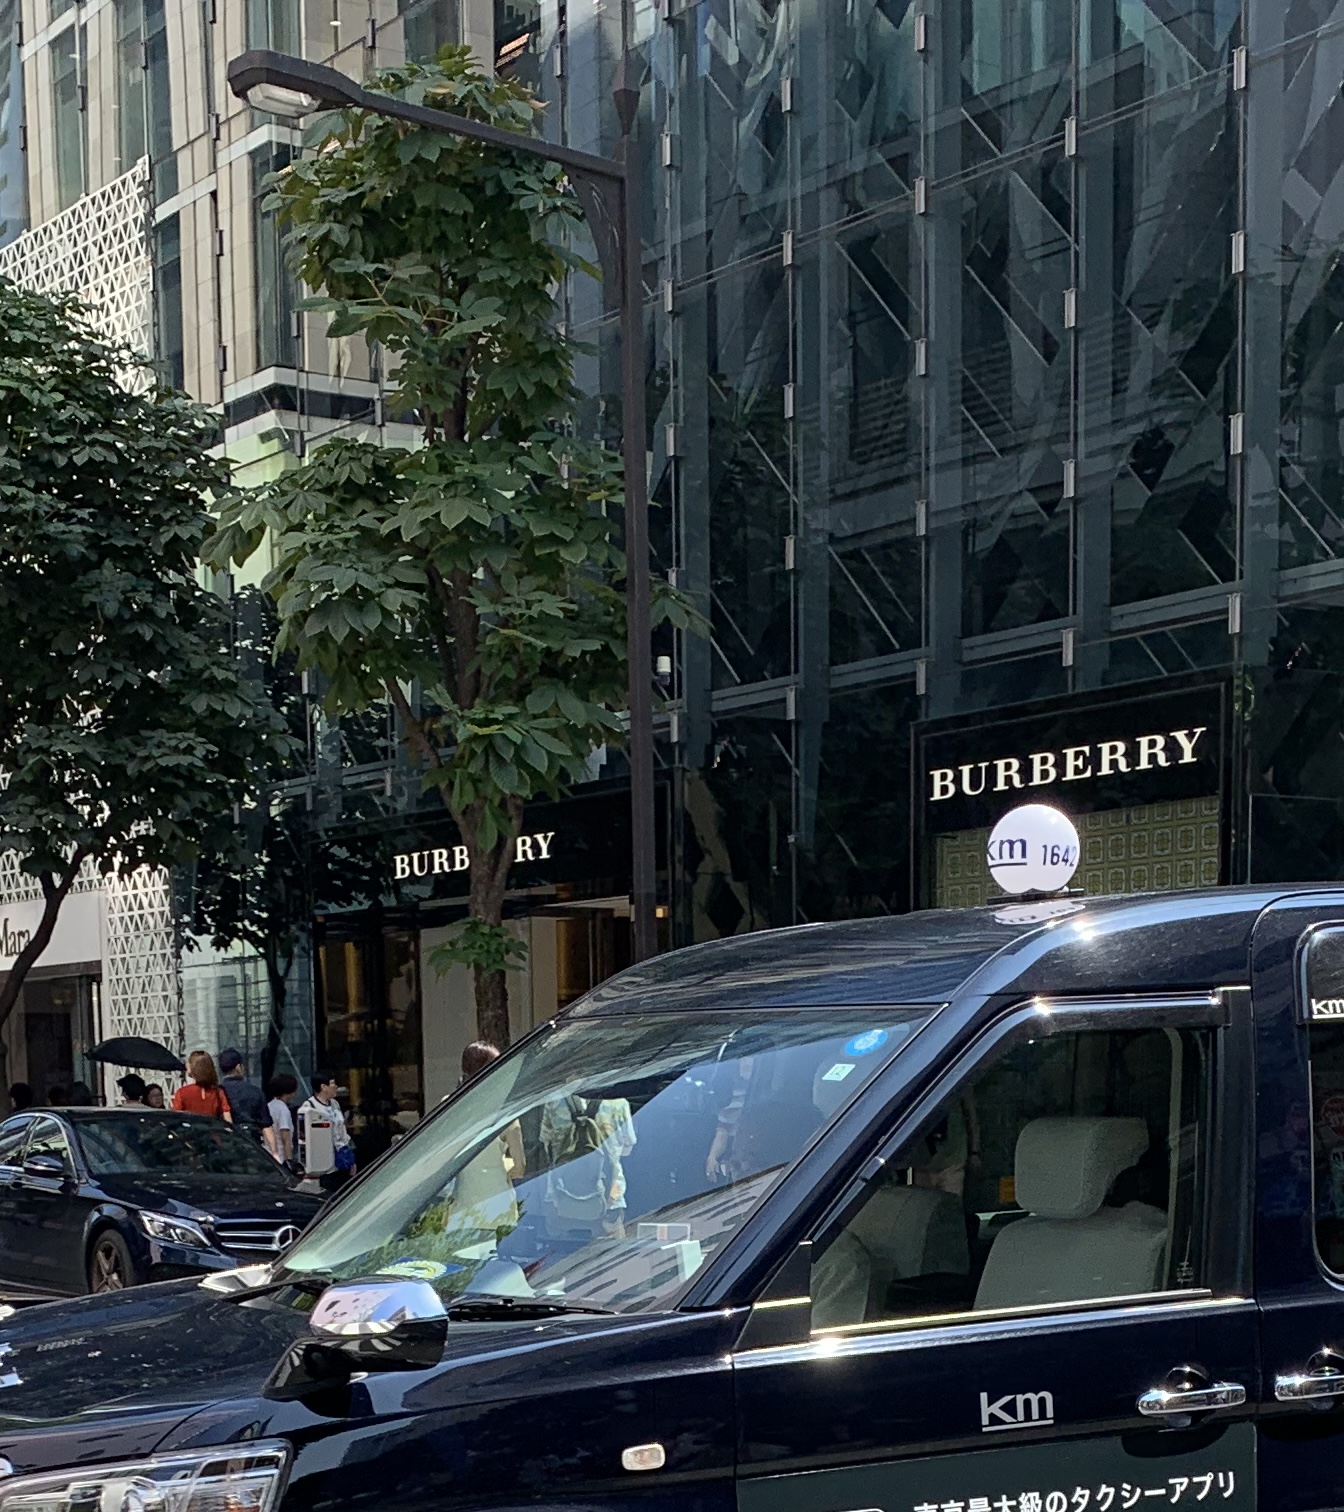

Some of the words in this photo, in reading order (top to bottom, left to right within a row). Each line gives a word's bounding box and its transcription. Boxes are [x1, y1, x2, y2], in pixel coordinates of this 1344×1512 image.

[929, 727, 1207, 801] BURBERRY
[393, 832, 555, 880] BURBRY
[1042, 844, 1077, 867] 1642
[980, 1390, 1054, 1432] km
